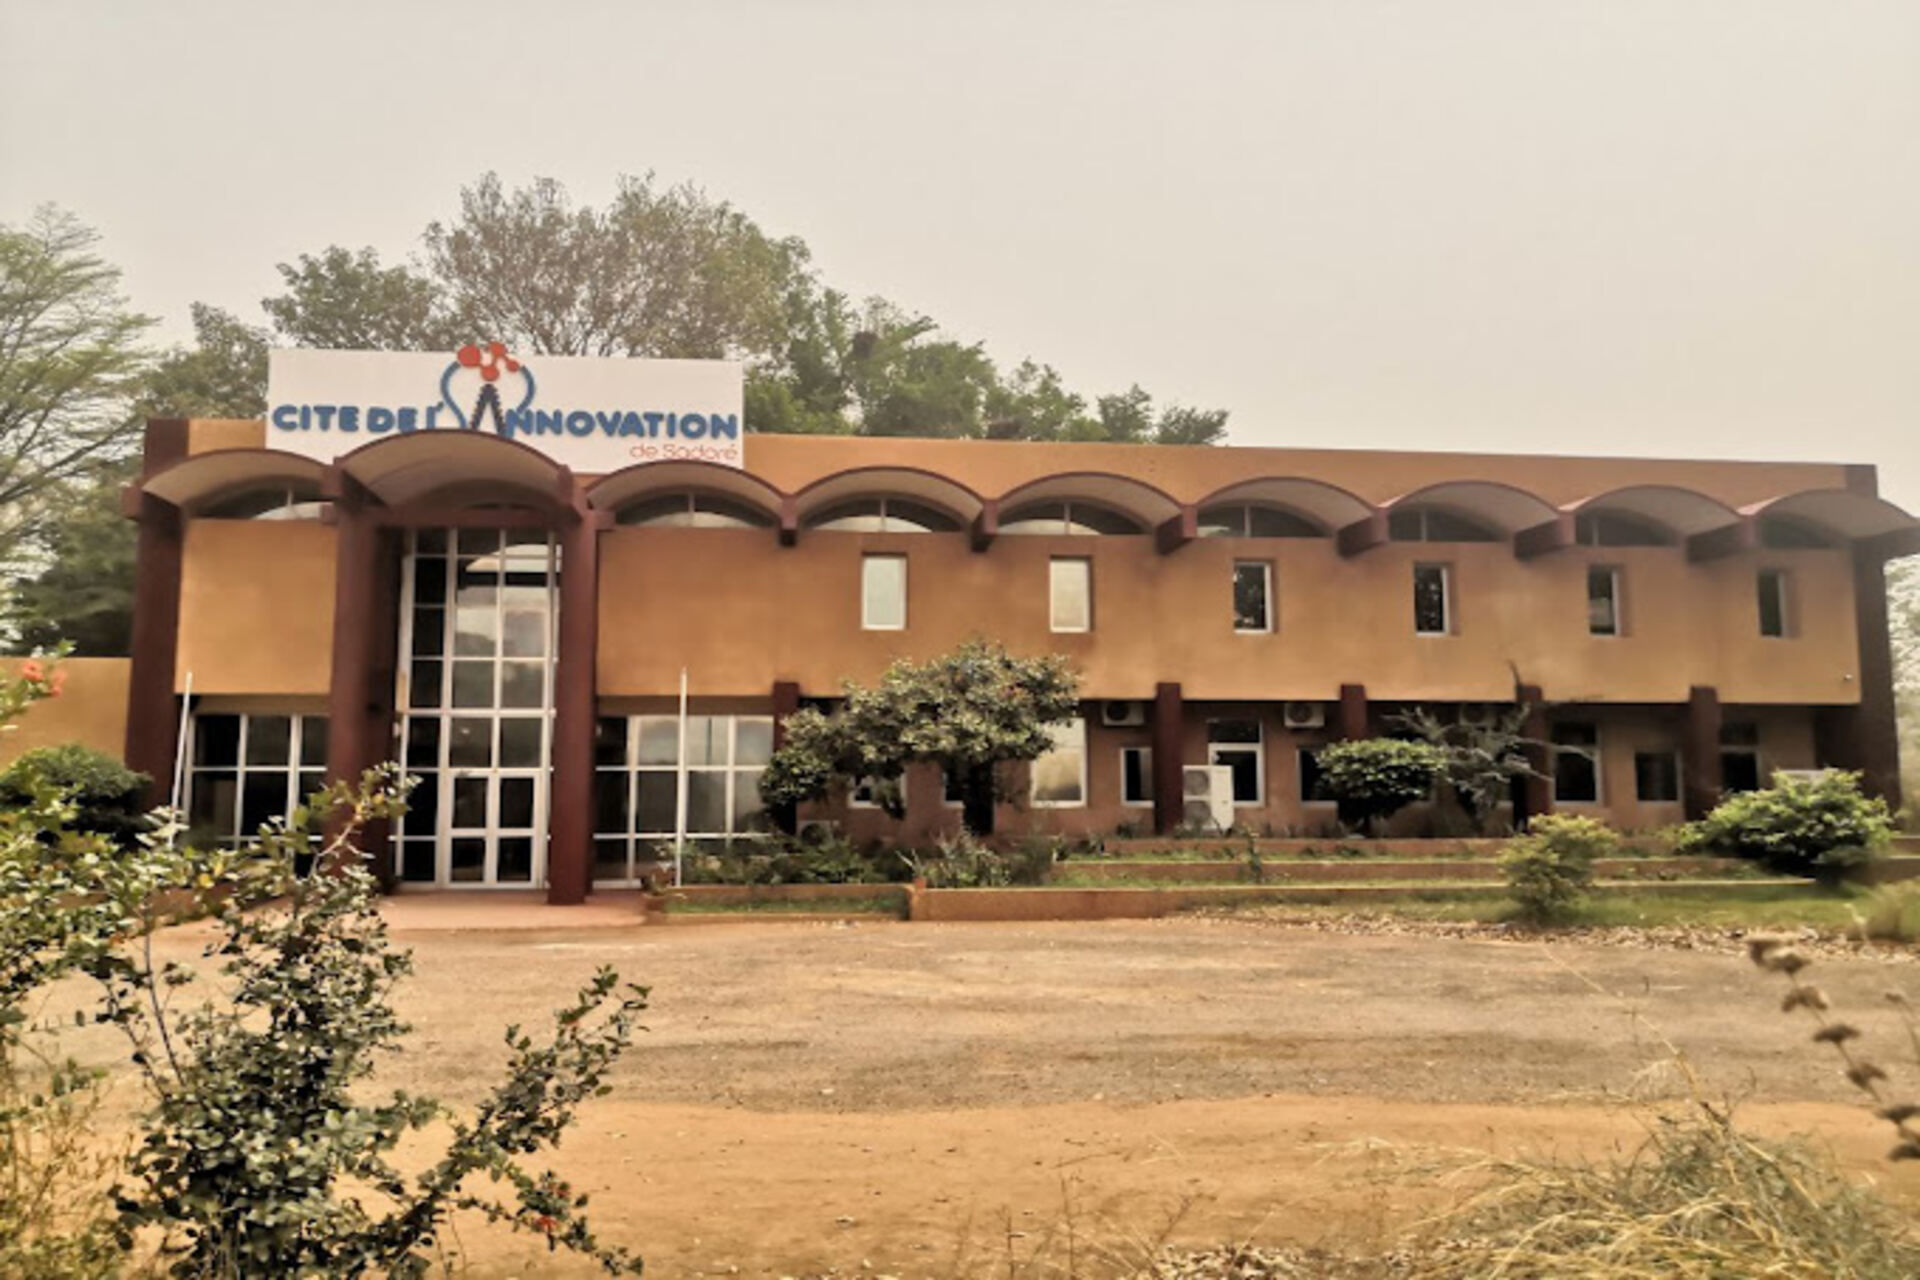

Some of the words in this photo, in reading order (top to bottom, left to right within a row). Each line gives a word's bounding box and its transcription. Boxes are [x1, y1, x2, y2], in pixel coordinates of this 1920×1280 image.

[272, 404, 360, 432] CITE
[366, 406, 418, 434] DE
[629, 443, 658, 459] de
